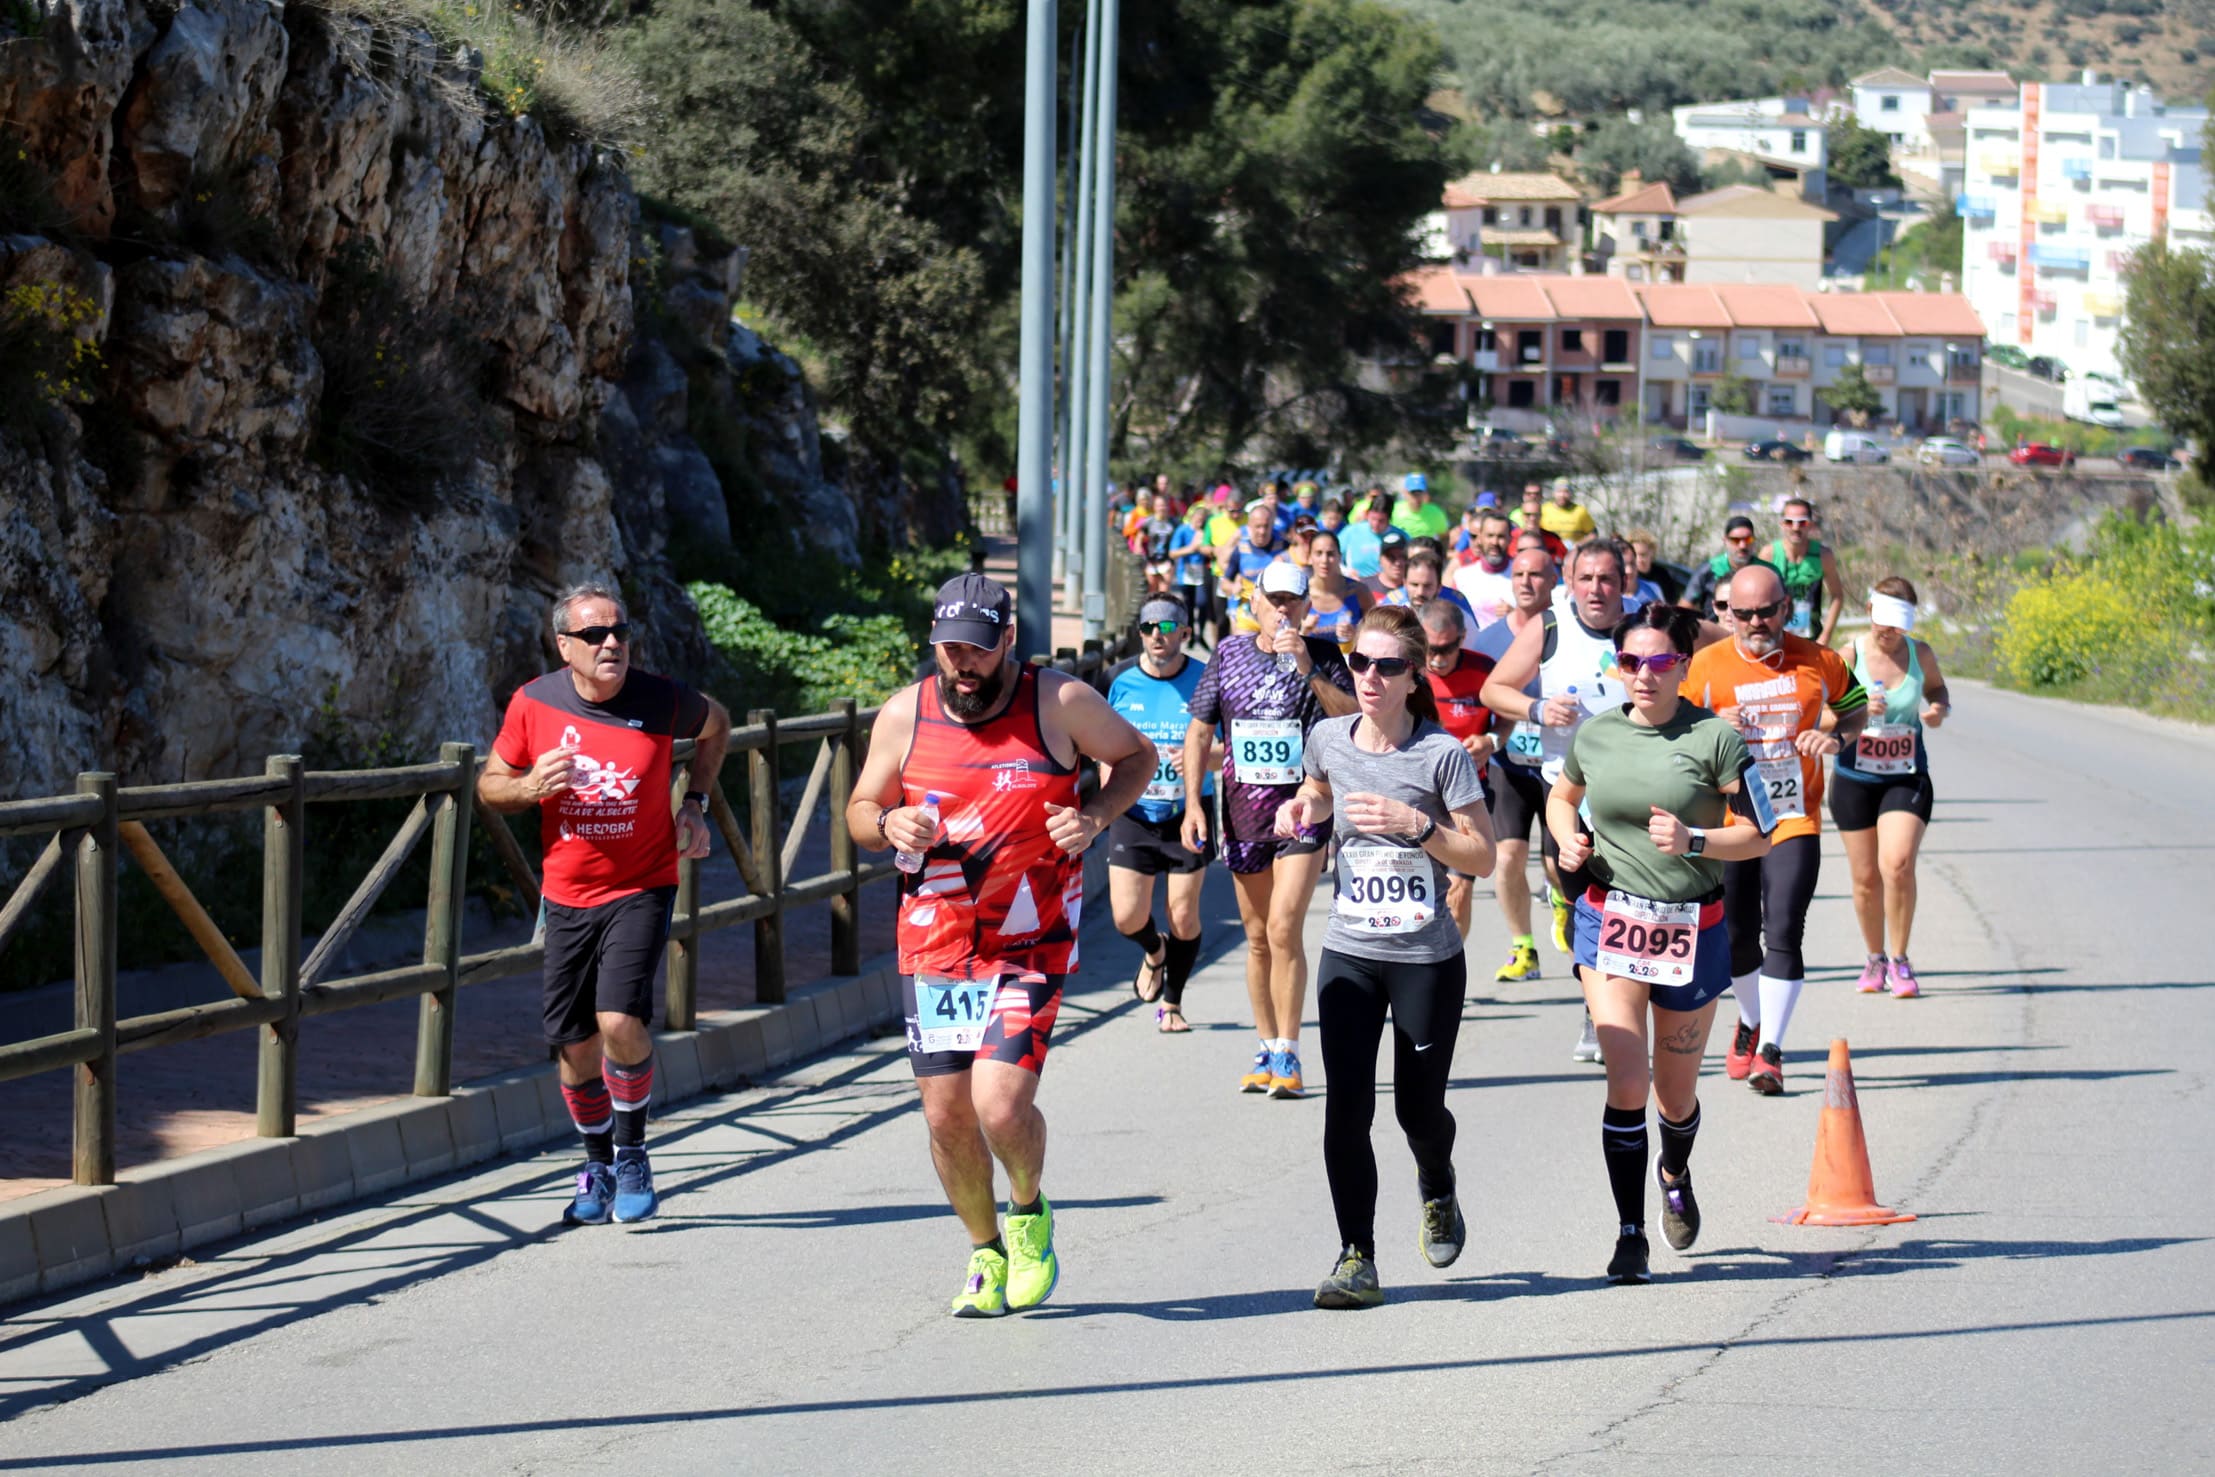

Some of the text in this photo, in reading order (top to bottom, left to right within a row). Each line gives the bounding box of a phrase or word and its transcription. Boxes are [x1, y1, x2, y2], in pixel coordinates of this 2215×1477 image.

[1243, 740, 1291, 764] 839
[1516, 735, 1540, 754] 37
[1861, 737, 1913, 758] 2009
[1350, 875, 1427, 904] 3096
[1604, 918, 1691, 958] 2095
[936, 989, 990, 1022] 415
